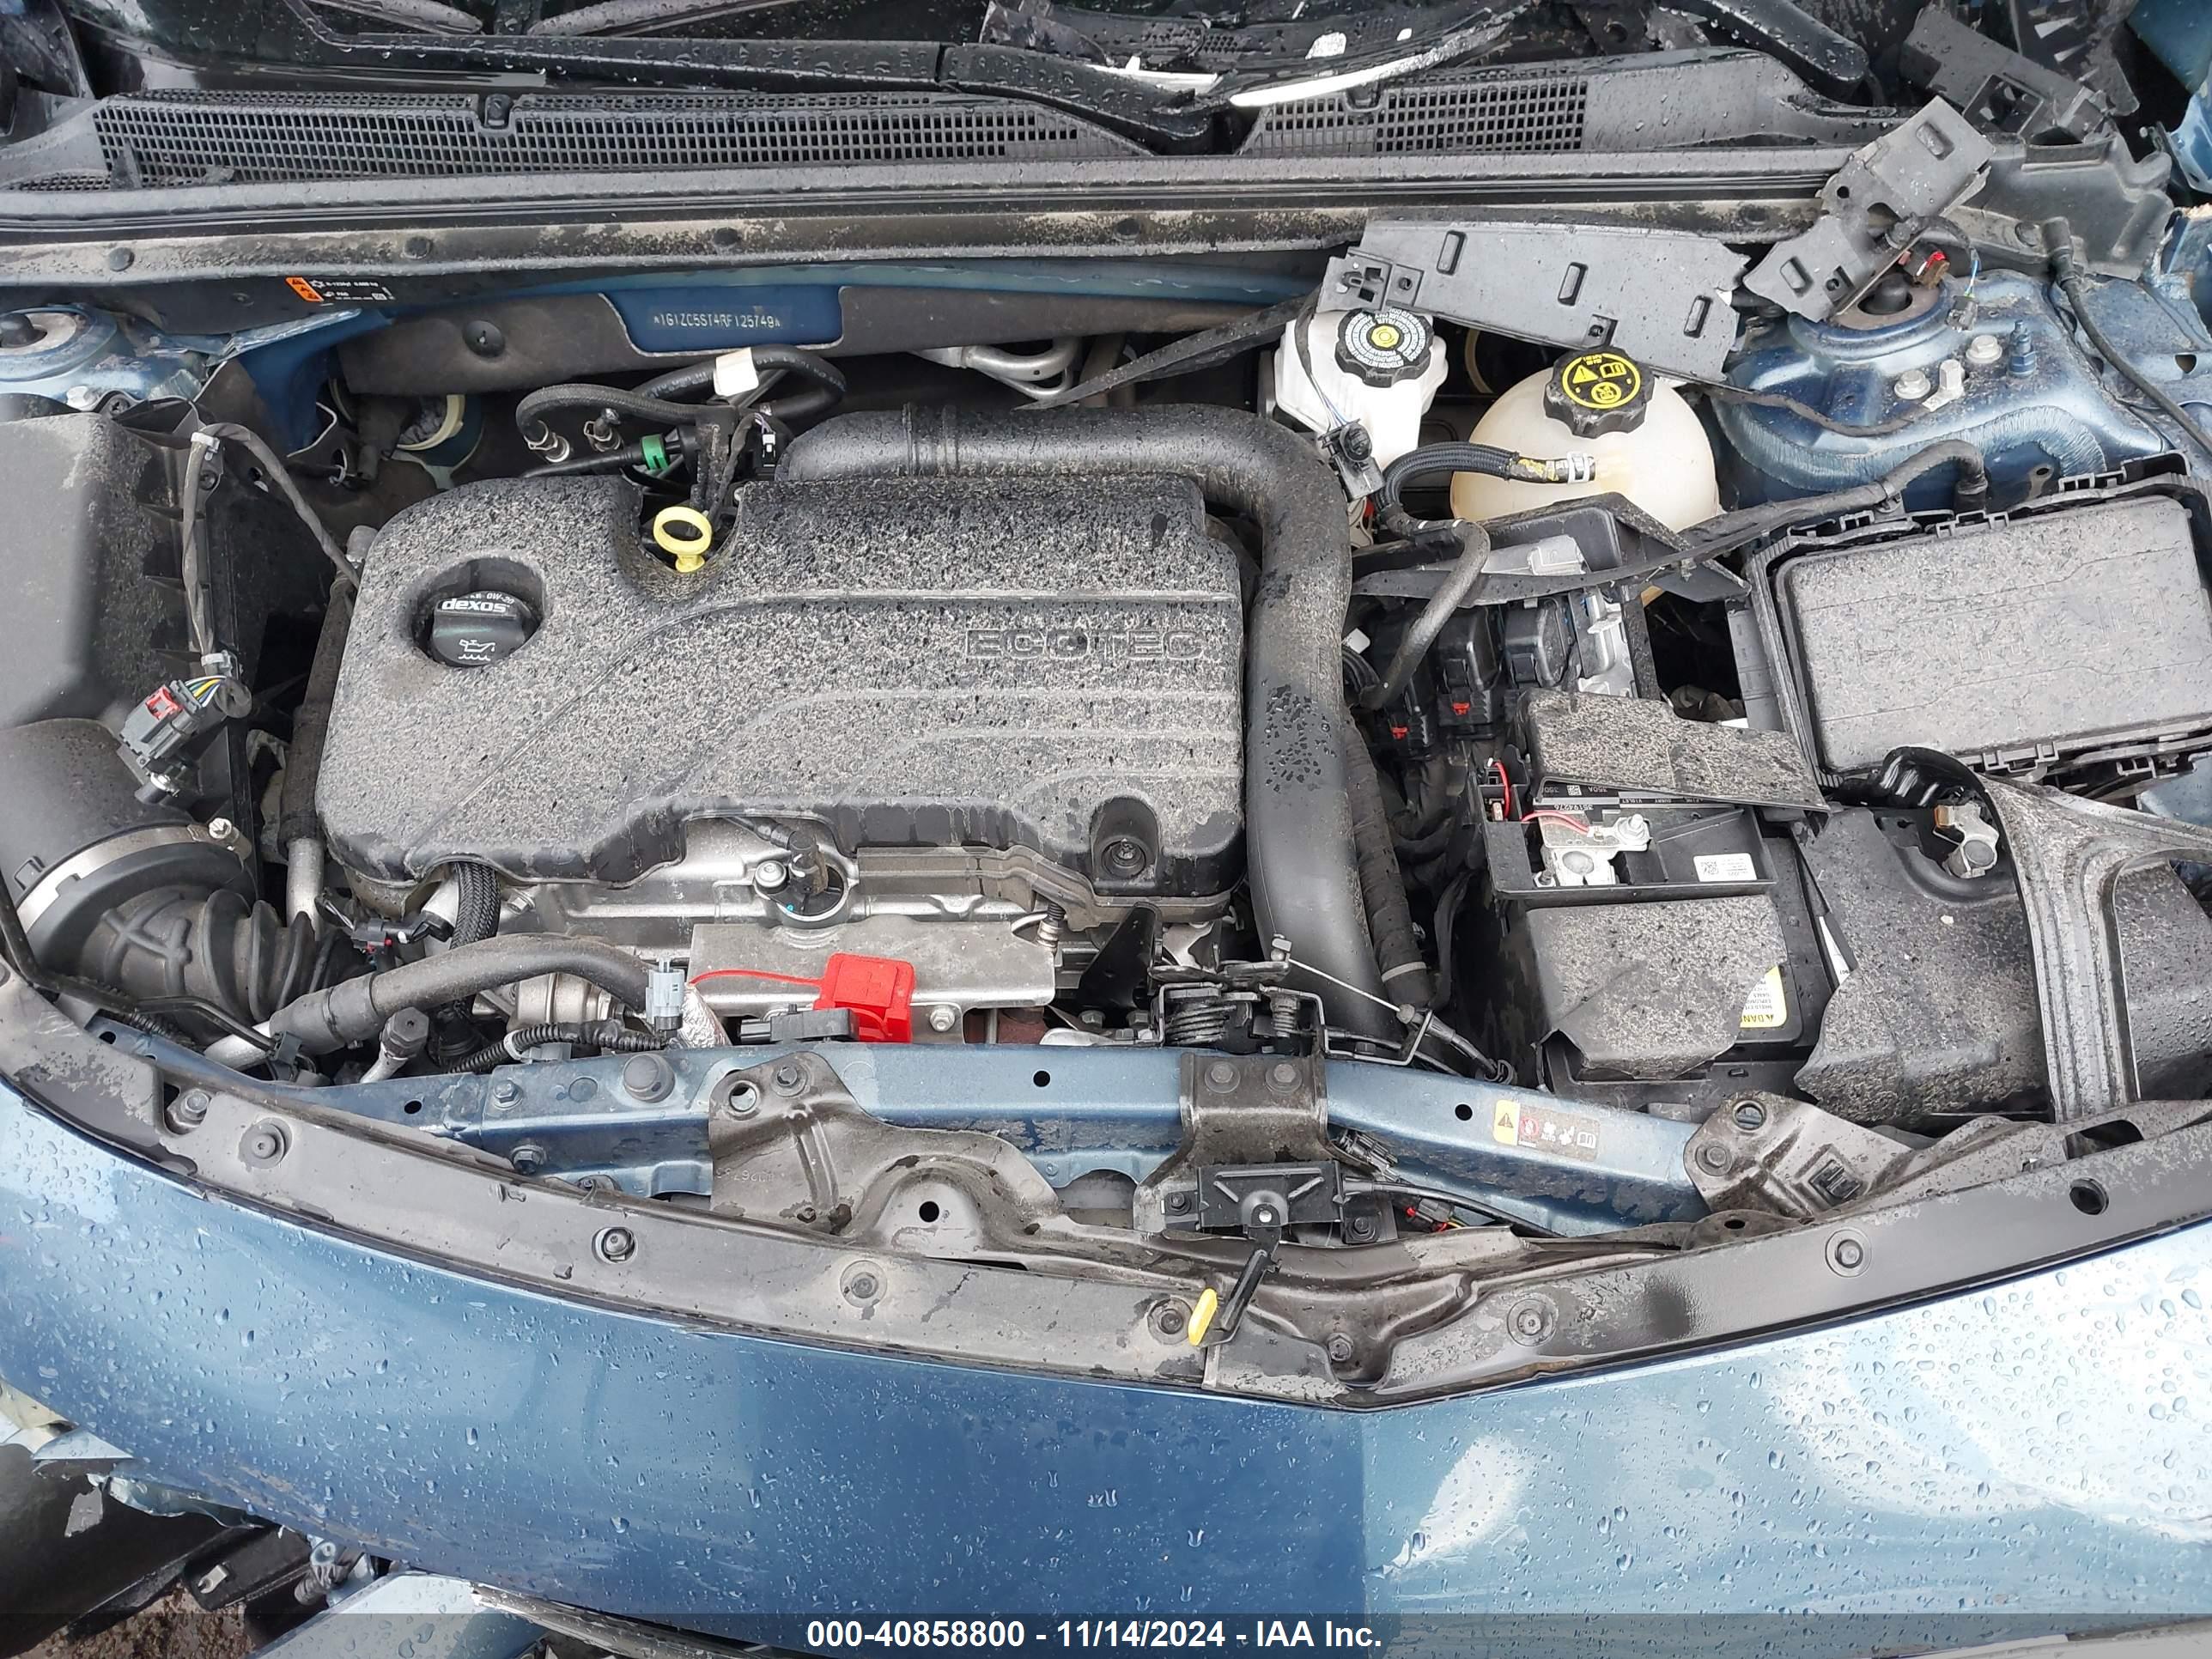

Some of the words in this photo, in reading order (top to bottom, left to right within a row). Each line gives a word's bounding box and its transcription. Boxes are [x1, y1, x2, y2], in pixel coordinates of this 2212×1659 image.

[441, 599, 507, 613] dexos
[966, 629, 1204, 659] ECOTEC
[1540, 1133, 1556, 1142] AUTO
